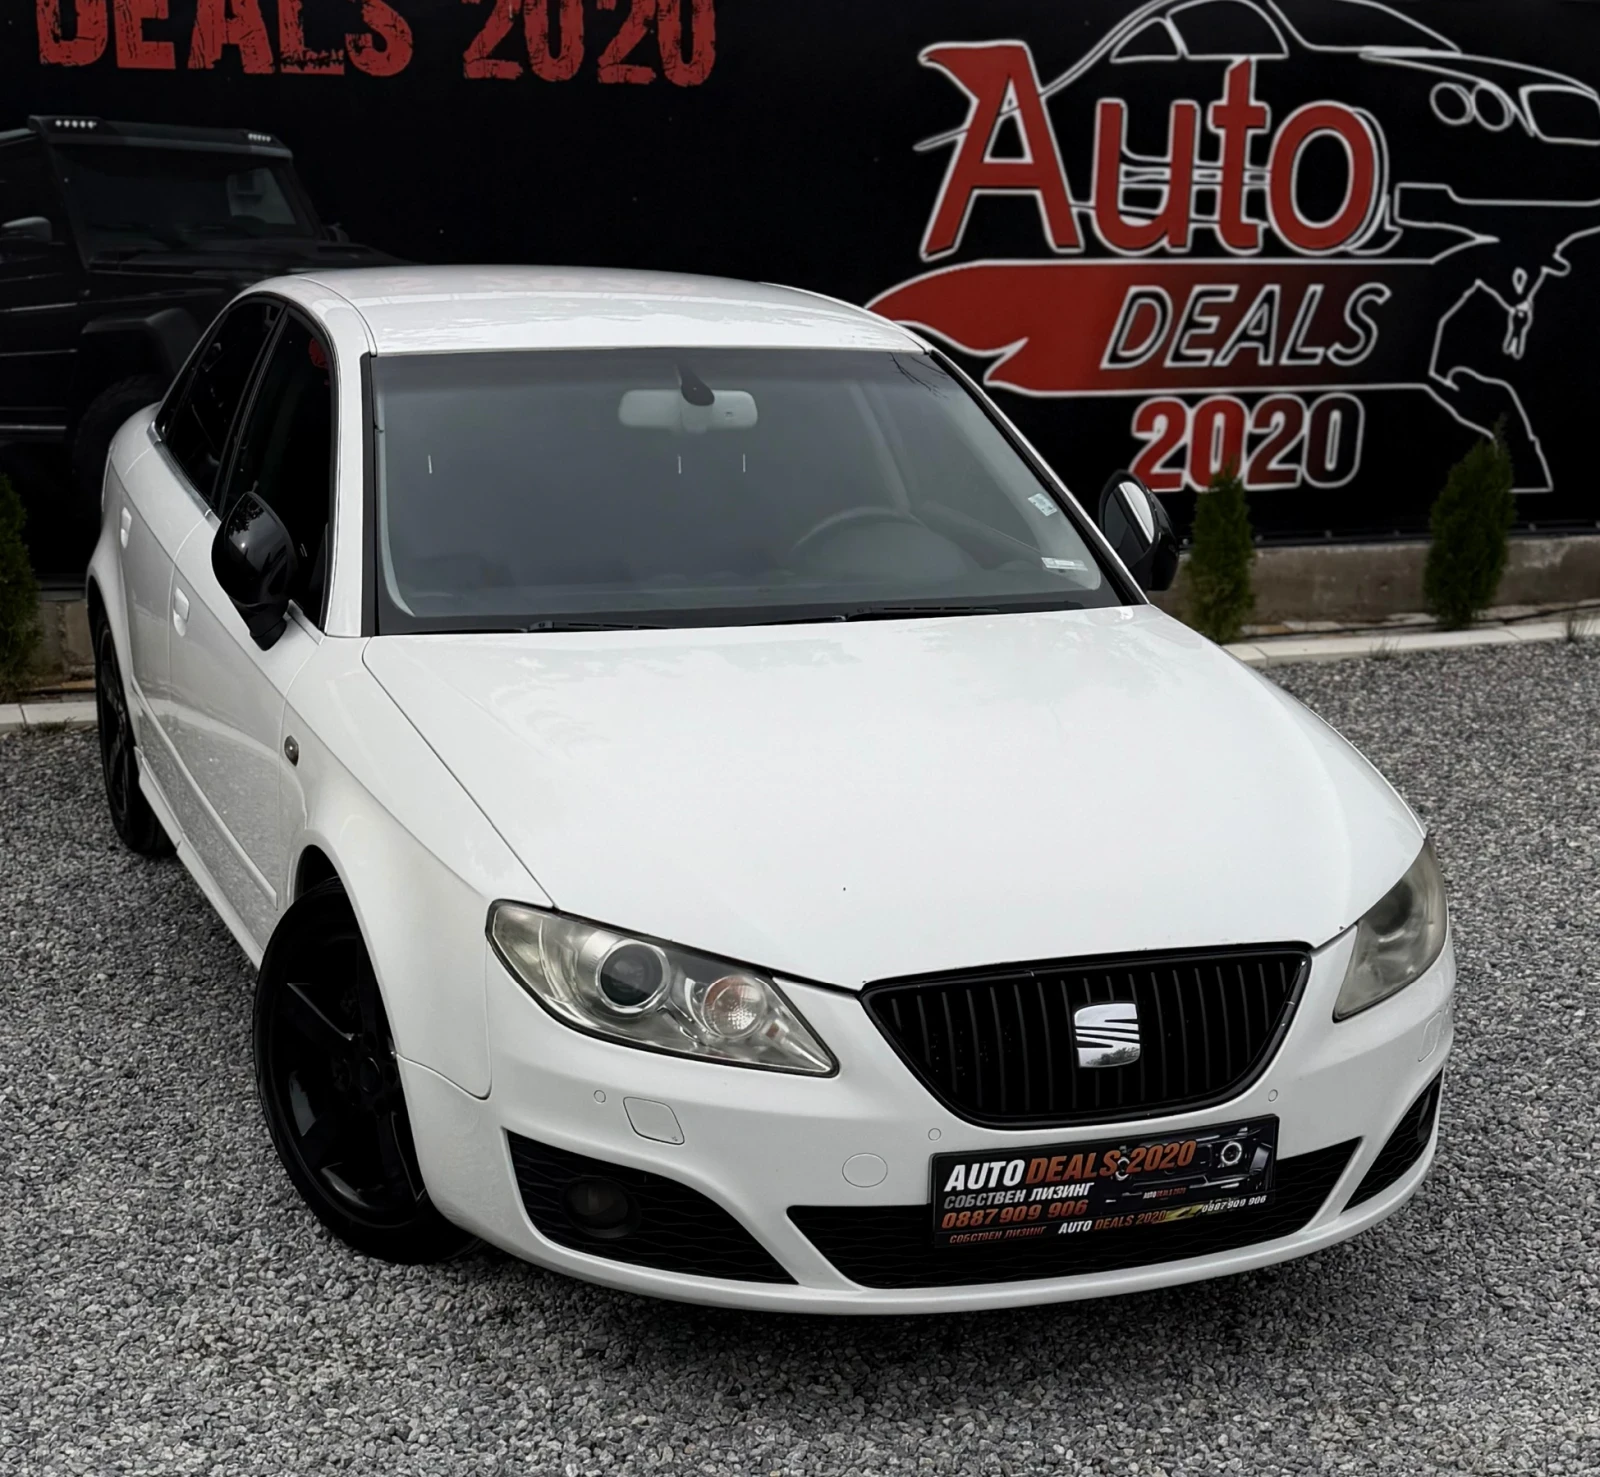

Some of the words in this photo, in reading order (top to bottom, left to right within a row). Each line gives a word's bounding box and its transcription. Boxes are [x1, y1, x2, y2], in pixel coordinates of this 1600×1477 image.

[36, 0, 413, 77] DEALS
[462, 0, 716, 87] 2020
[918, 40, 1382, 261] Auto
[1100, 282, 1391, 370] DEALS
[1128, 392, 1366, 493] 2020
[943, 1159, 1026, 1192] AUTO
[1025, 1149, 1121, 1185] DEALS
[1124, 1140, 1198, 1174] 2020
[941, 1208, 999, 1229] 0887
[999, 1204, 1043, 1223] 909
[1048, 1200, 1089, 1218] 906
[943, 1189, 1027, 1209] СОБСТВЕН
[1028, 1182, 1095, 1201] ЛИЗИНГ
[949, 1231, 1003, 1244] СОБСТВЕН
[1058, 1220, 1092, 1234] AUTO
[1093, 1215, 1134, 1231] DEALS
[1136, 1210, 1167, 1225] 2020
